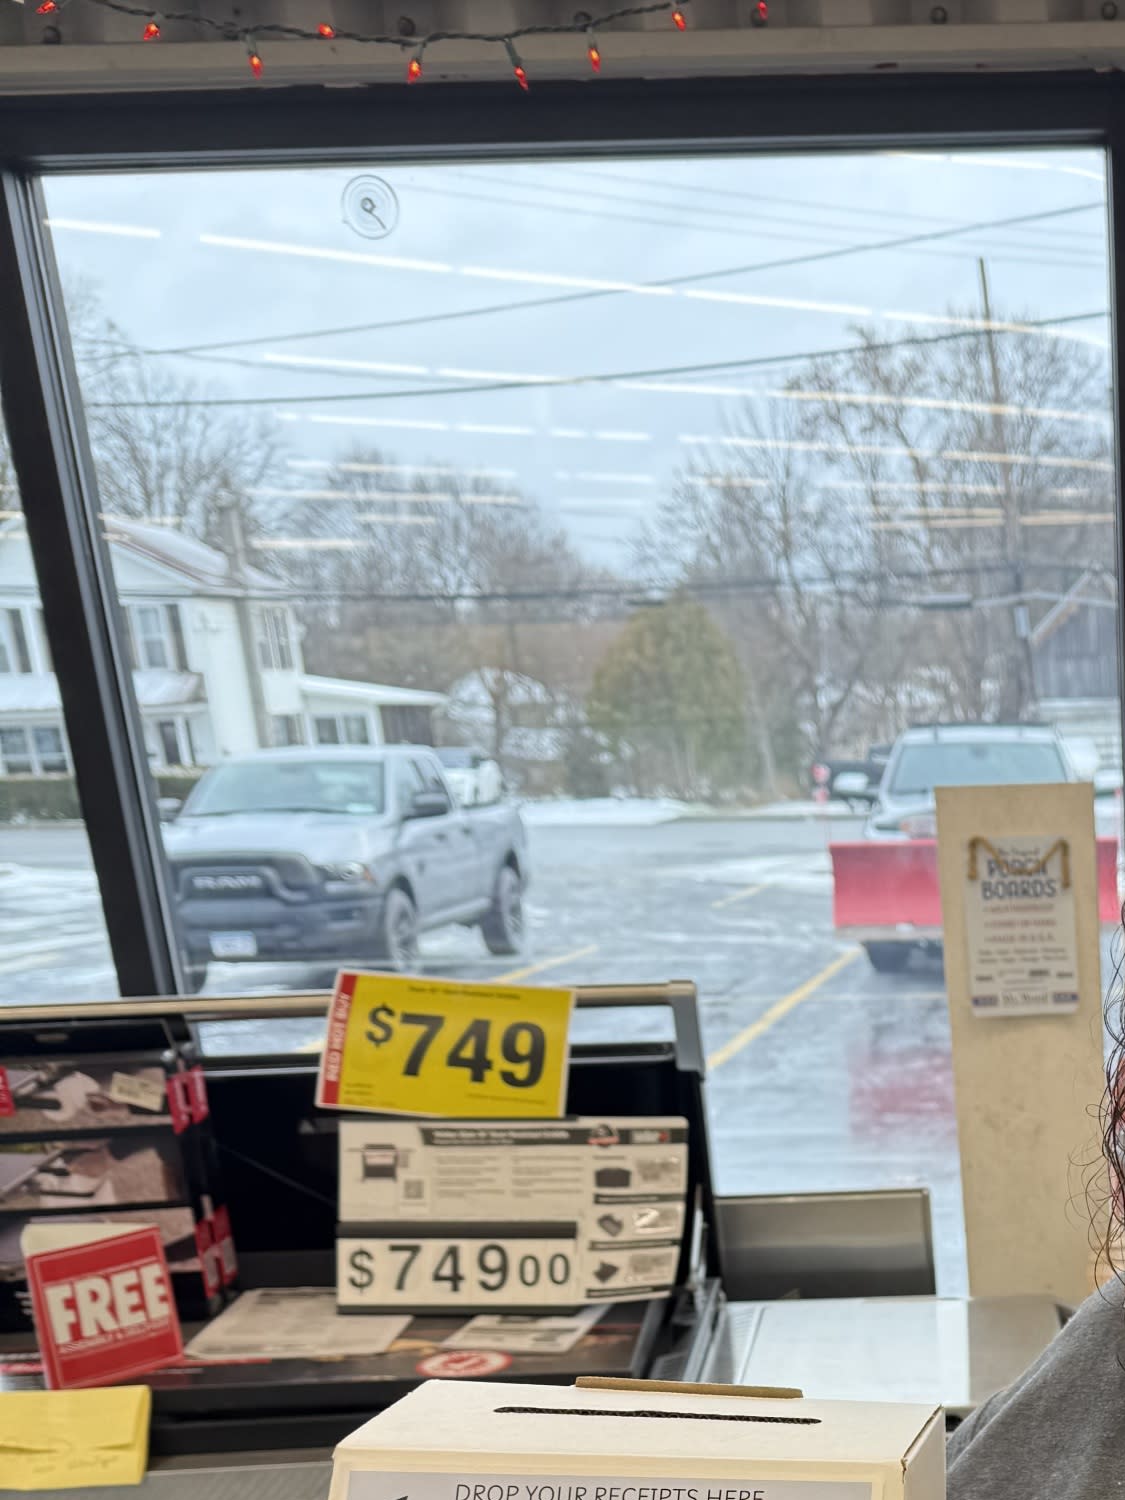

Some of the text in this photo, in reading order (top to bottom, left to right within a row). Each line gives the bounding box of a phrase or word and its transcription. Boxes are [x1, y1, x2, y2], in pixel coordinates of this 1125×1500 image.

[192, 876, 262, 889] RAM
[982, 878, 1057, 900] BOARDS
[365, 1002, 546, 1089] $749
[44, 1263, 170, 1345] FREE
